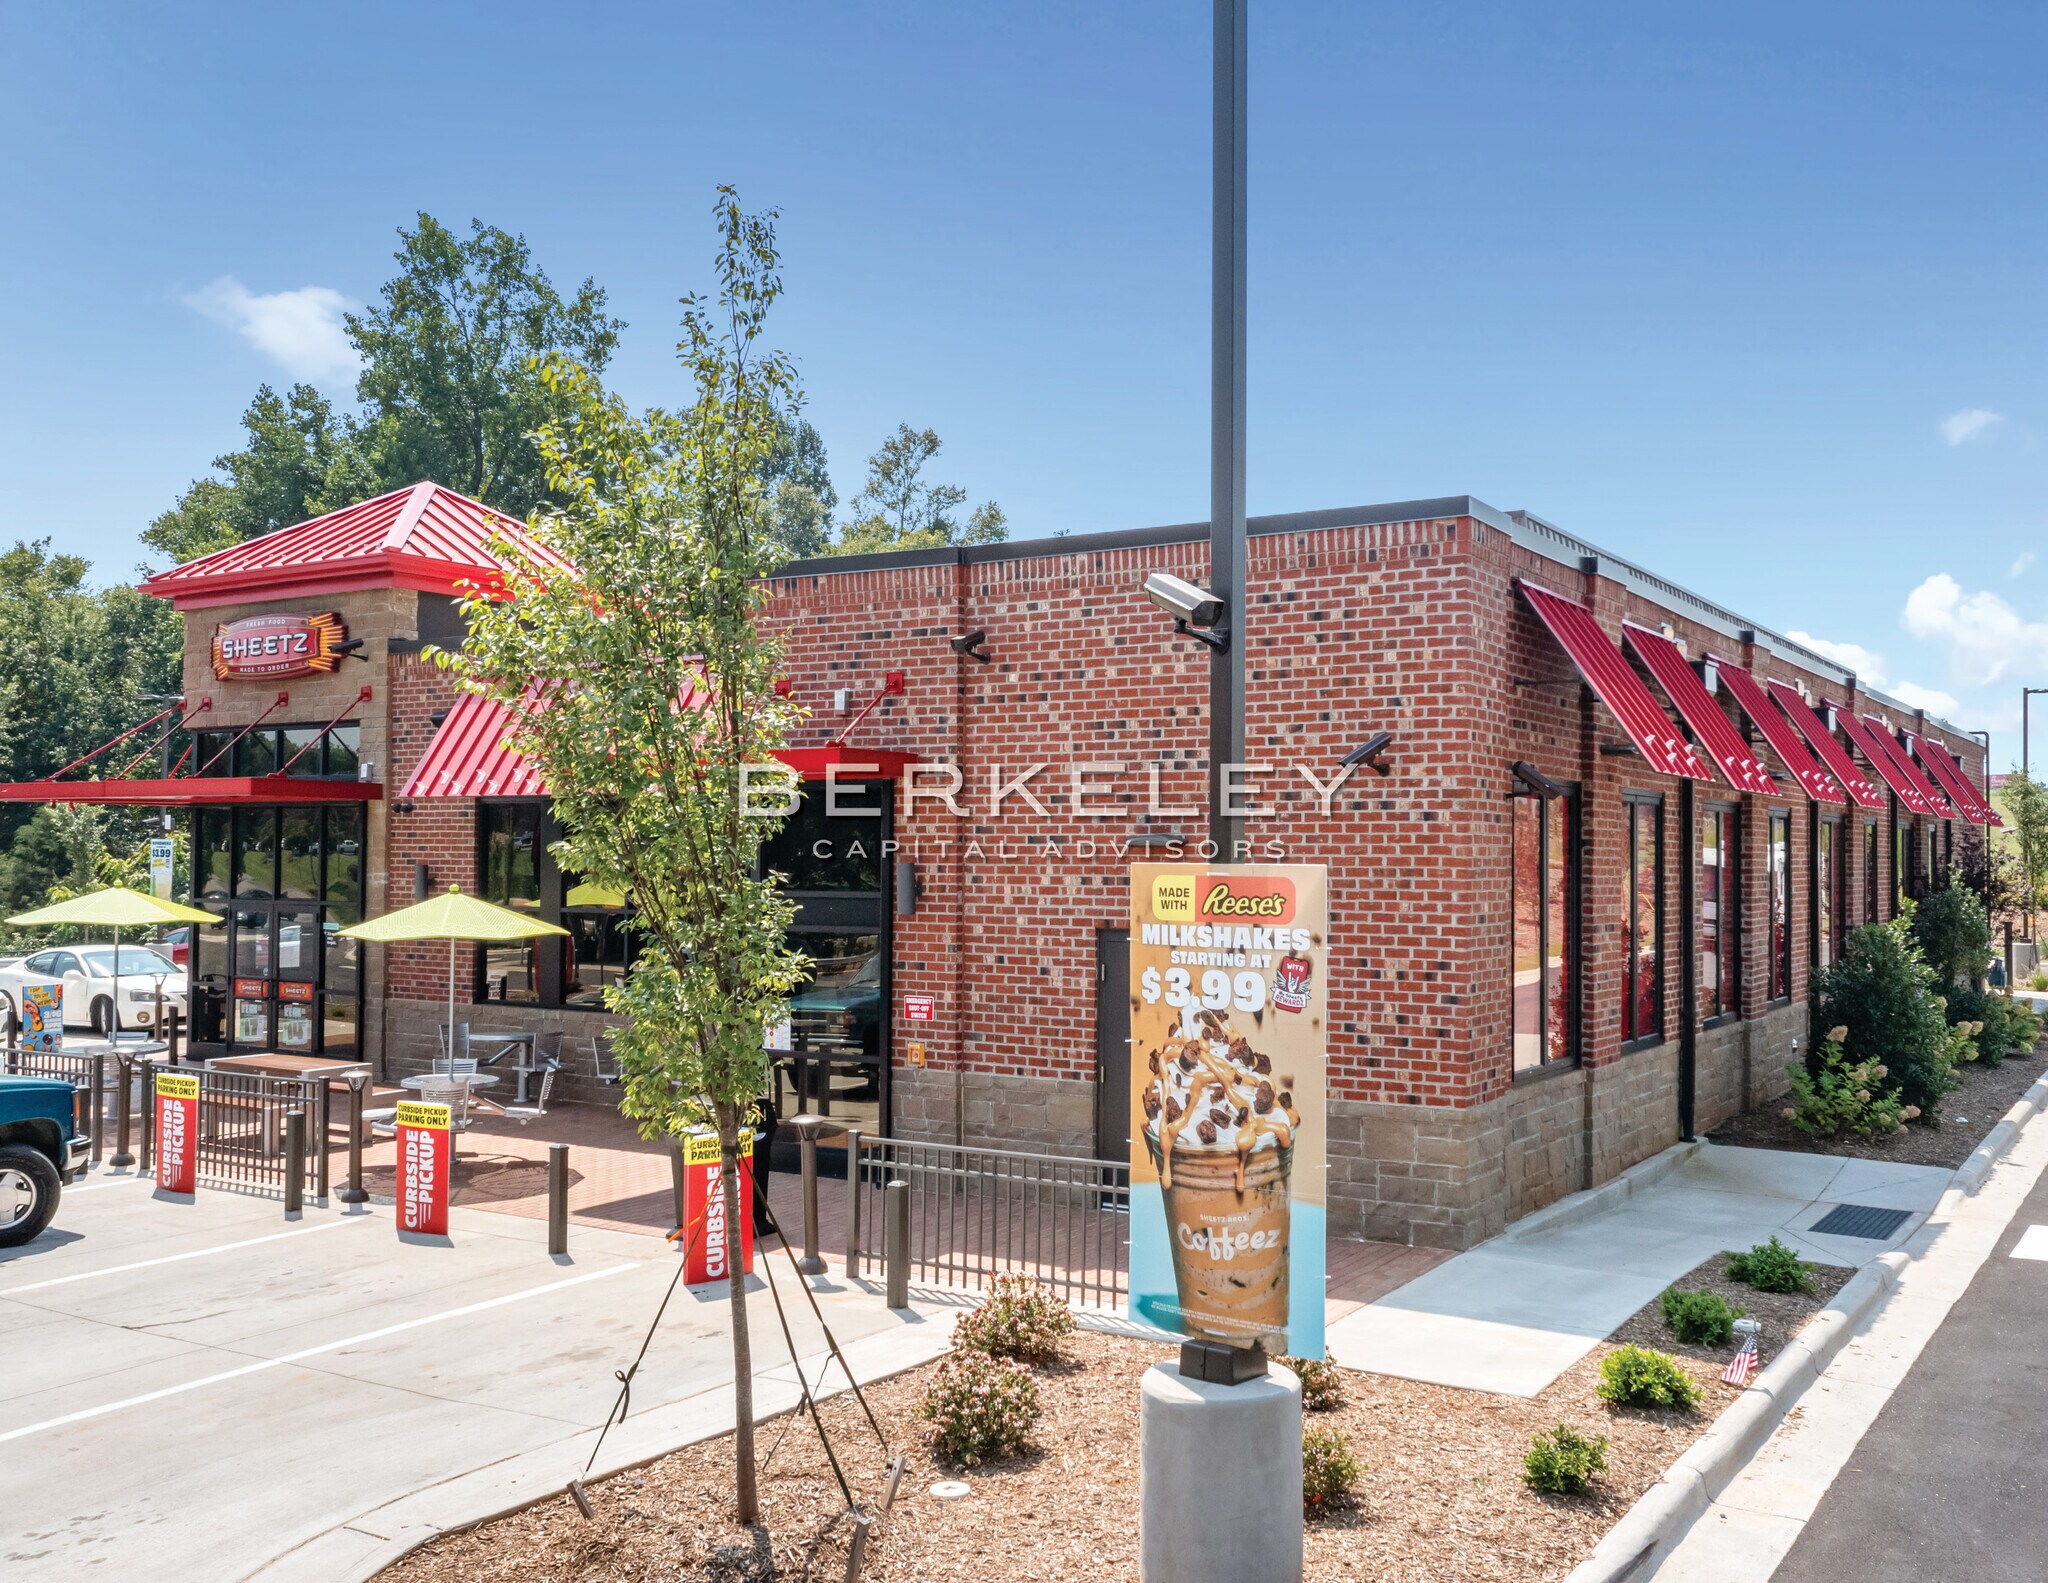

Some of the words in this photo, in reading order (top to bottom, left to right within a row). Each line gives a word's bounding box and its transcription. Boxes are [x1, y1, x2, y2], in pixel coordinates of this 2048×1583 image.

[222, 633, 309, 659] SHEETZ
[267, 663, 290, 671] ORDER
[1158, 887, 1190, 898] MADE
[1201, 882, 1287, 917] Reese's
[1160, 899, 1188, 911] WITH
[1141, 923, 1311, 951] MILKSHAKES
[1170, 950, 1246, 968] STARTING
[1250, 954, 1273, 969] AT
[1286, 962, 1305, 973] WITH
[285, 987, 306, 995] SHEETZ
[1141, 966, 1267, 1013] $3.99
[1274, 993, 1305, 1007] REWARDZ
[157, 1076, 176, 1086] CURBSIDE
[176, 1079, 196, 1087] PICKUP
[157, 1084, 178, 1095] PARKING
[178, 1087, 196, 1096] ONLY
[398, 1104, 423, 1115] CURBSIDE
[424, 1107, 448, 1116] PICKUP
[398, 1112, 425, 1124] PARKING
[426, 1116, 448, 1126] ONLY
[172, 1100, 185, 1165] PICKUP
[162, 1099, 173, 1187] CURBSIDE
[418, 1130, 435, 1204] PICKUP
[405, 1129, 419, 1228] CURBSIDE
[1200, 1213, 1226, 1223] SHEETZ
[1227, 1214, 1249, 1223] BROS.
[1177, 1222, 1281, 1261] Coffeez
